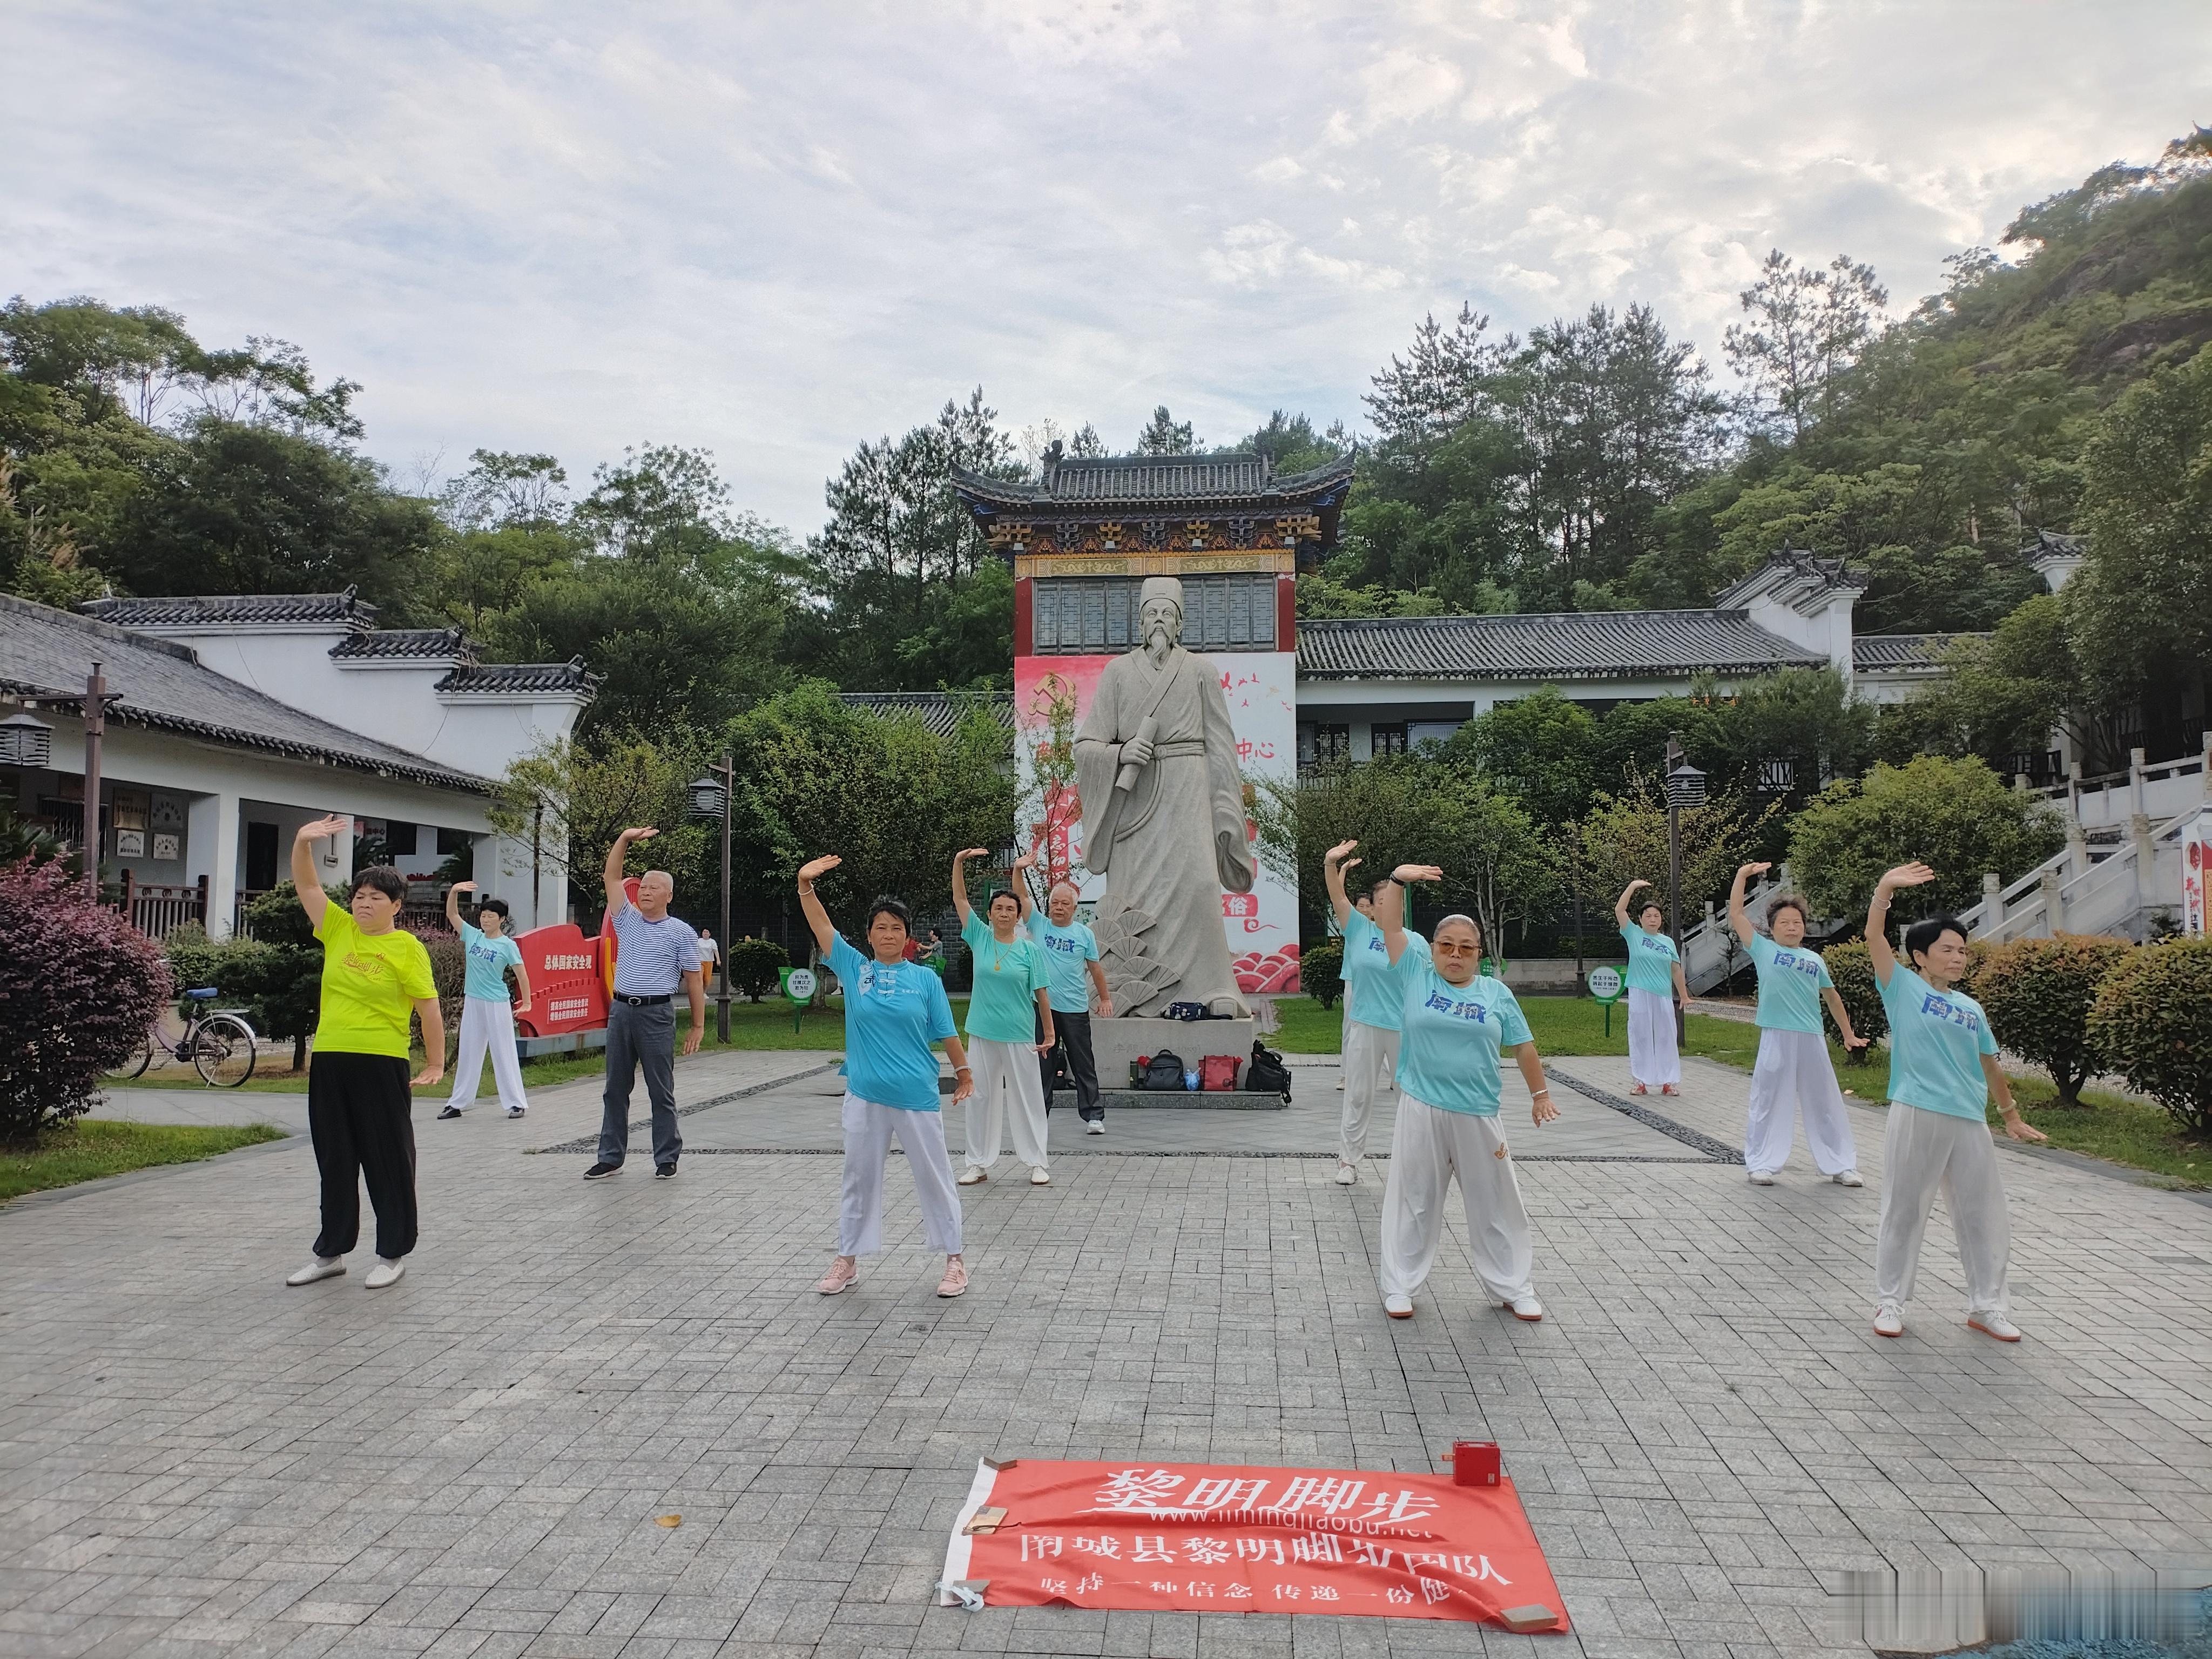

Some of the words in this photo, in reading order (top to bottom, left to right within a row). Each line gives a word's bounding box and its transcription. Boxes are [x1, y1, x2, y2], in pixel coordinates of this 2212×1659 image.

[1236, 738, 1274, 763] 中心
[1223, 896, 1248, 915] 俗
[544, 954, 592, 970] 总体国家安全观
[1093, 1468, 1440, 1526] 黎明脚步
[1041, 1572, 1253, 1599] 坚持一种信念
[1271, 1576, 1468, 1605] 传递一份健
